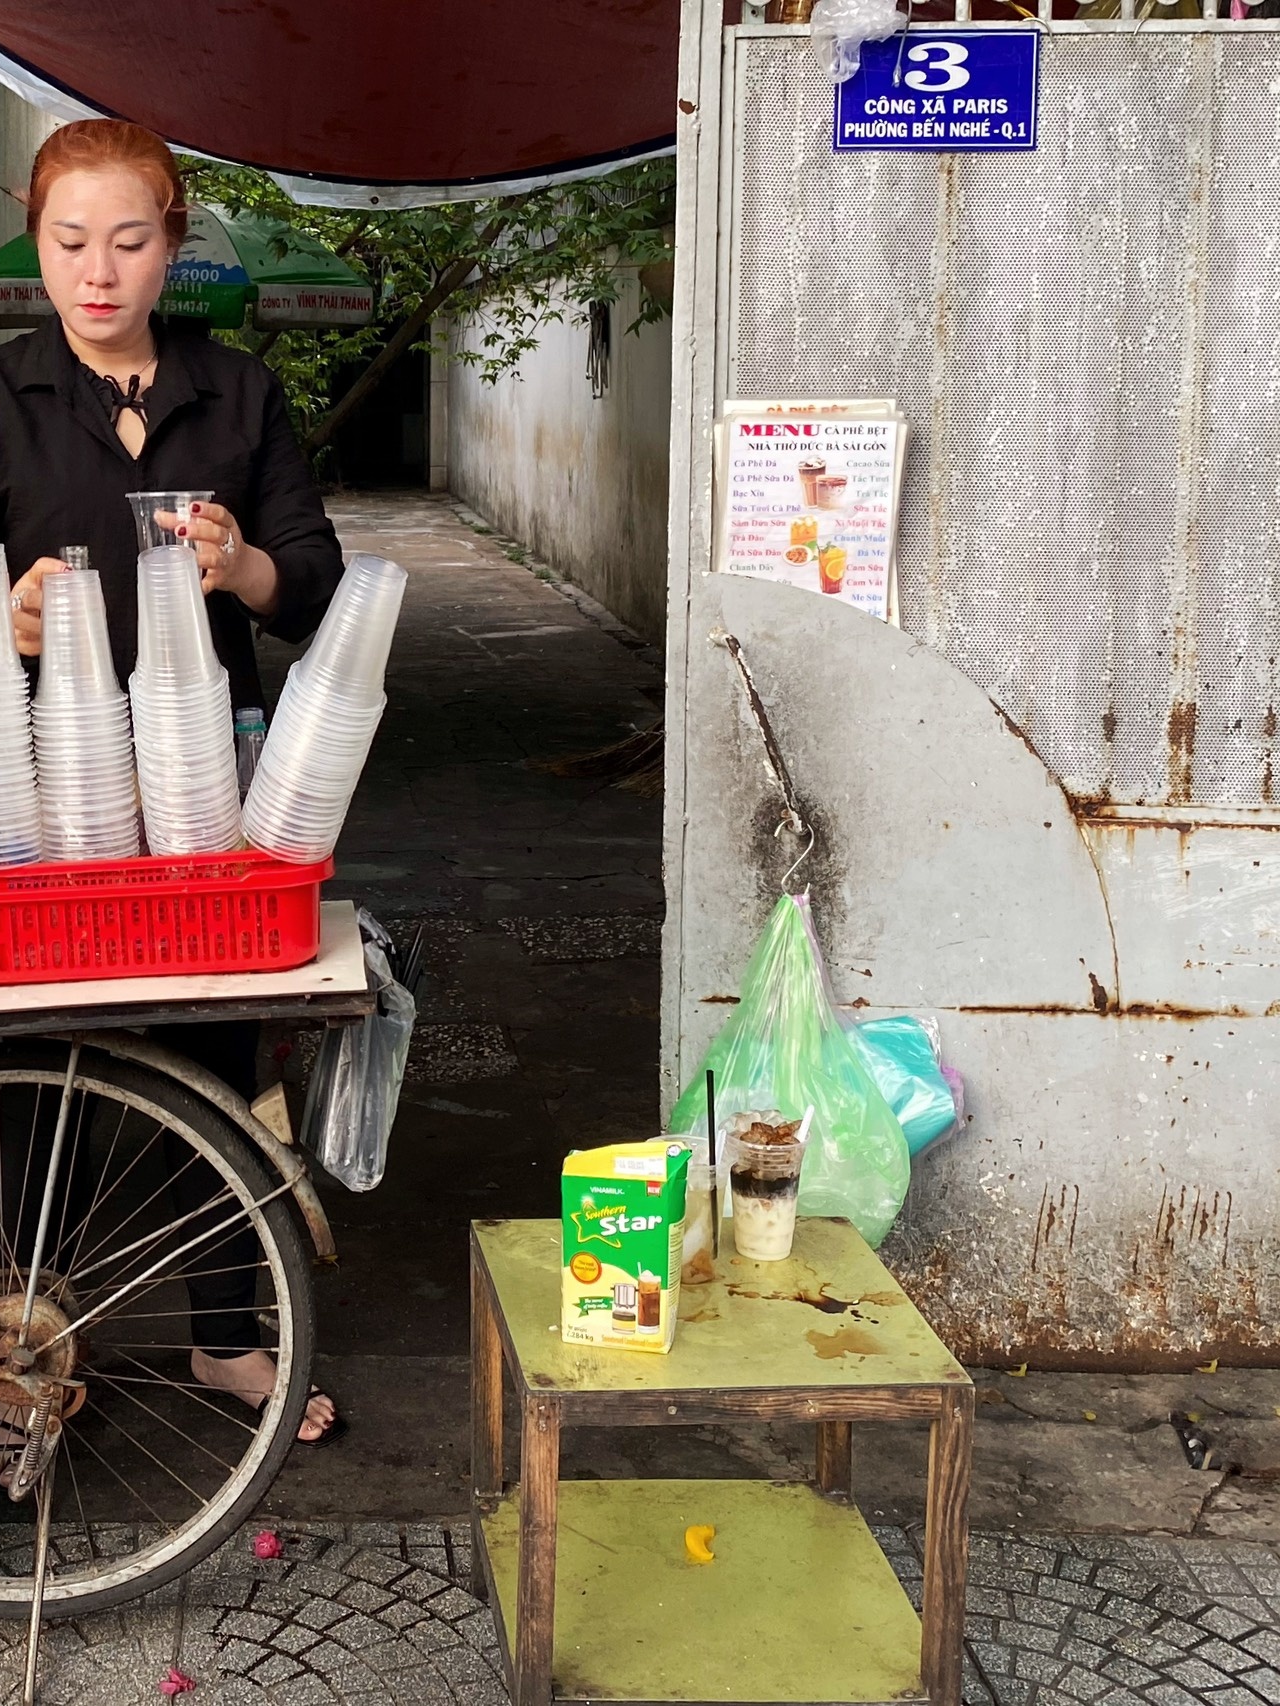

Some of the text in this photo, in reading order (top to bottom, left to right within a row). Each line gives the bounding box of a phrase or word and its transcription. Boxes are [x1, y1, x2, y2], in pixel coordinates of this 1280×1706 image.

[904, 41, 970, 92] 3
[864, 95, 1008, 115] CÔNG XÃ PARIS
[844, 119, 908, 138] PHƯỜNG
[912, 116, 945, 137] BẾN
[950, 118, 990, 137] NGHÉ
[262, 295, 280, 309] CÔNG
[296, 291, 317, 308] VĨNH
[340, 293, 370, 311] THÀNH
[739, 424, 888, 437] MENU CÀ PHÊ BỆT
[748, 442, 771, 451] NHÀ
[774, 441, 798, 451] THỜ
[800, 441, 824, 451] ĐỨC
[826, 441, 840, 451] BÀ
[863, 441, 888, 451] GÒN
[585, 1205, 626, 1221] Southern
[585, 1334, 594, 1342] kg
